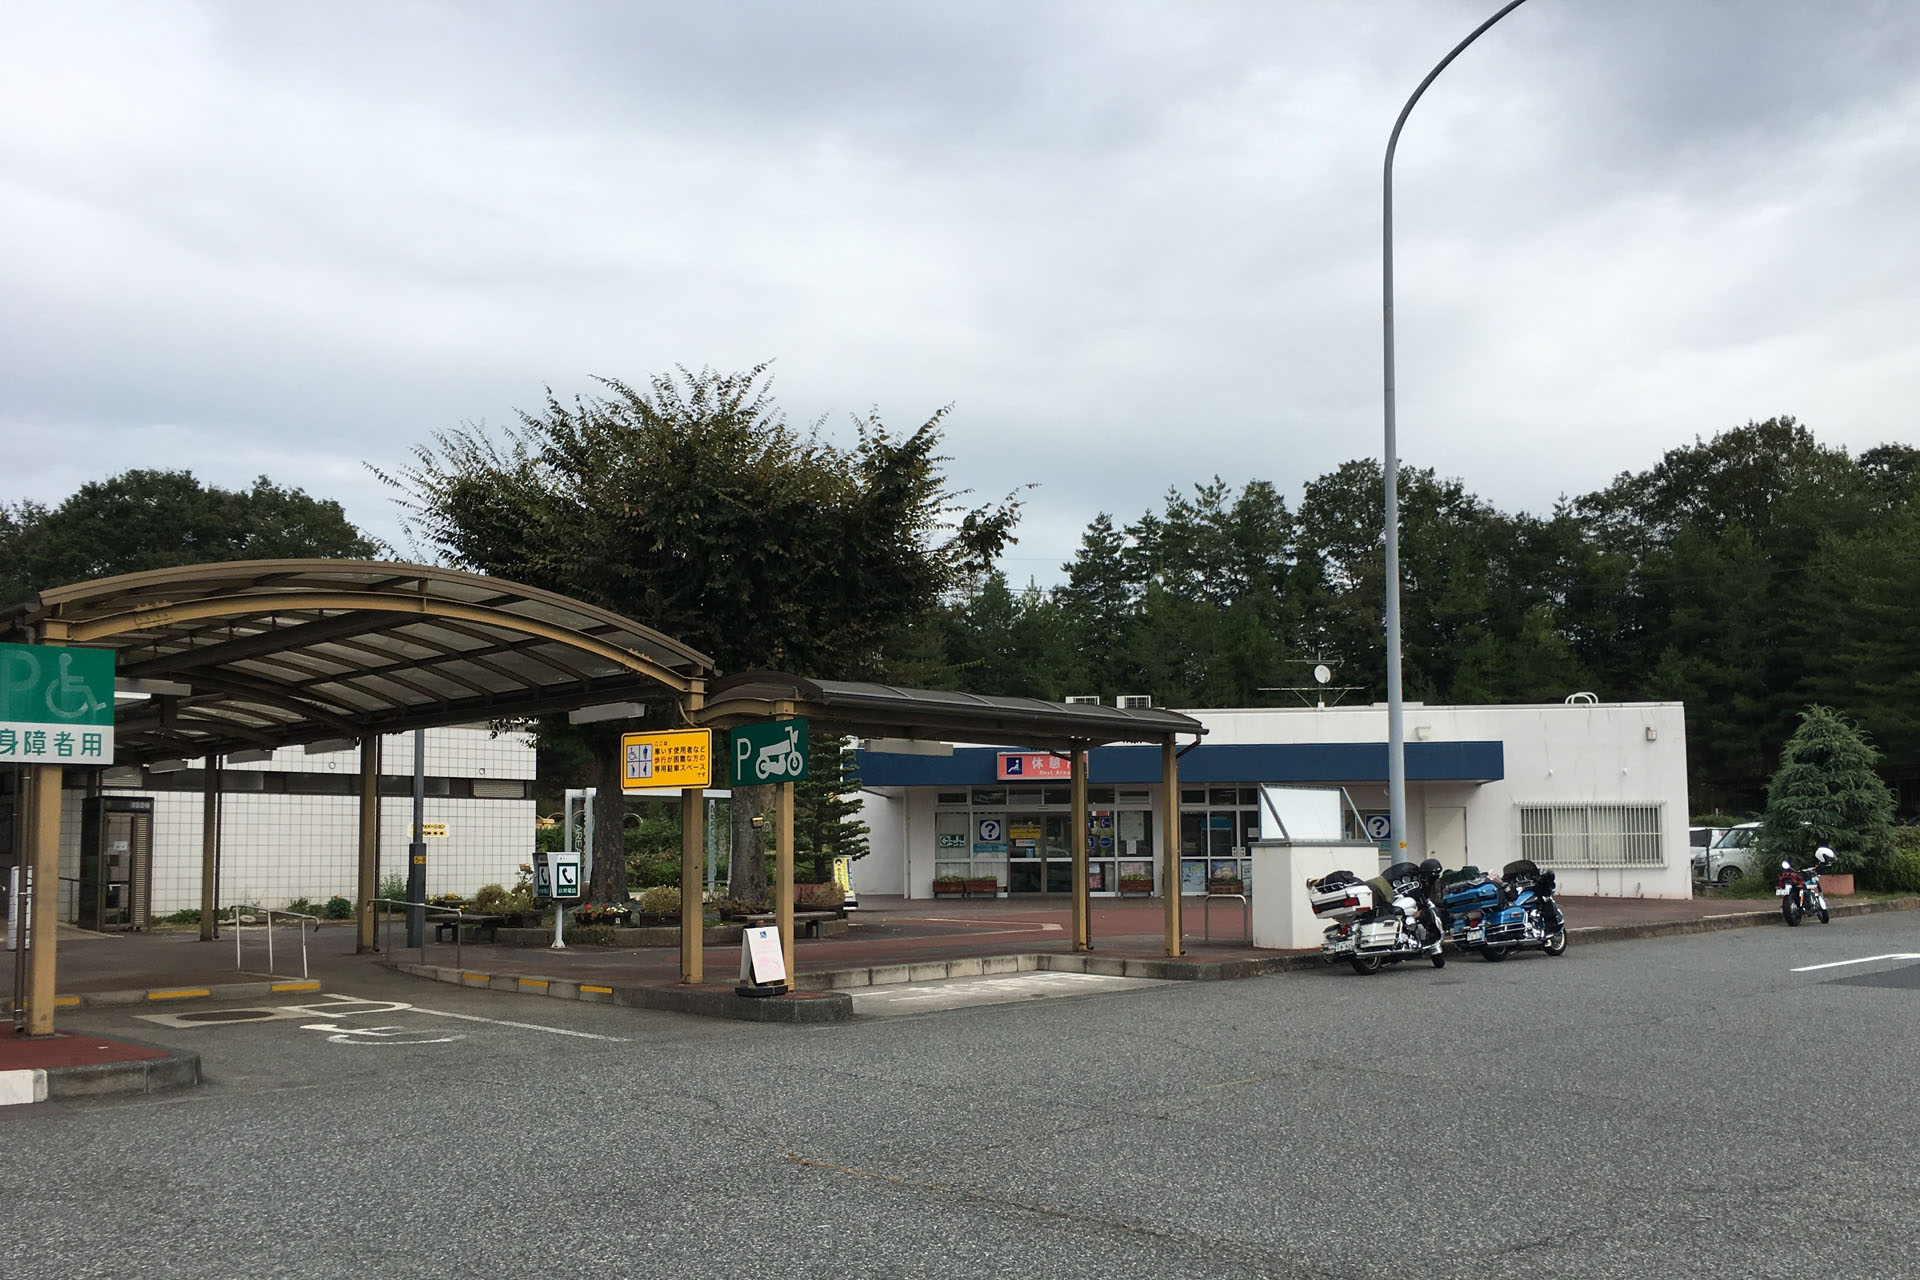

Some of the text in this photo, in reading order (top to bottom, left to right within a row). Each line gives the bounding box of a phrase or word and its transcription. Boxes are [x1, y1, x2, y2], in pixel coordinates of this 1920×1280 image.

[0, 728, 102, 757] 身障者用
[737, 738, 751, 780] P
